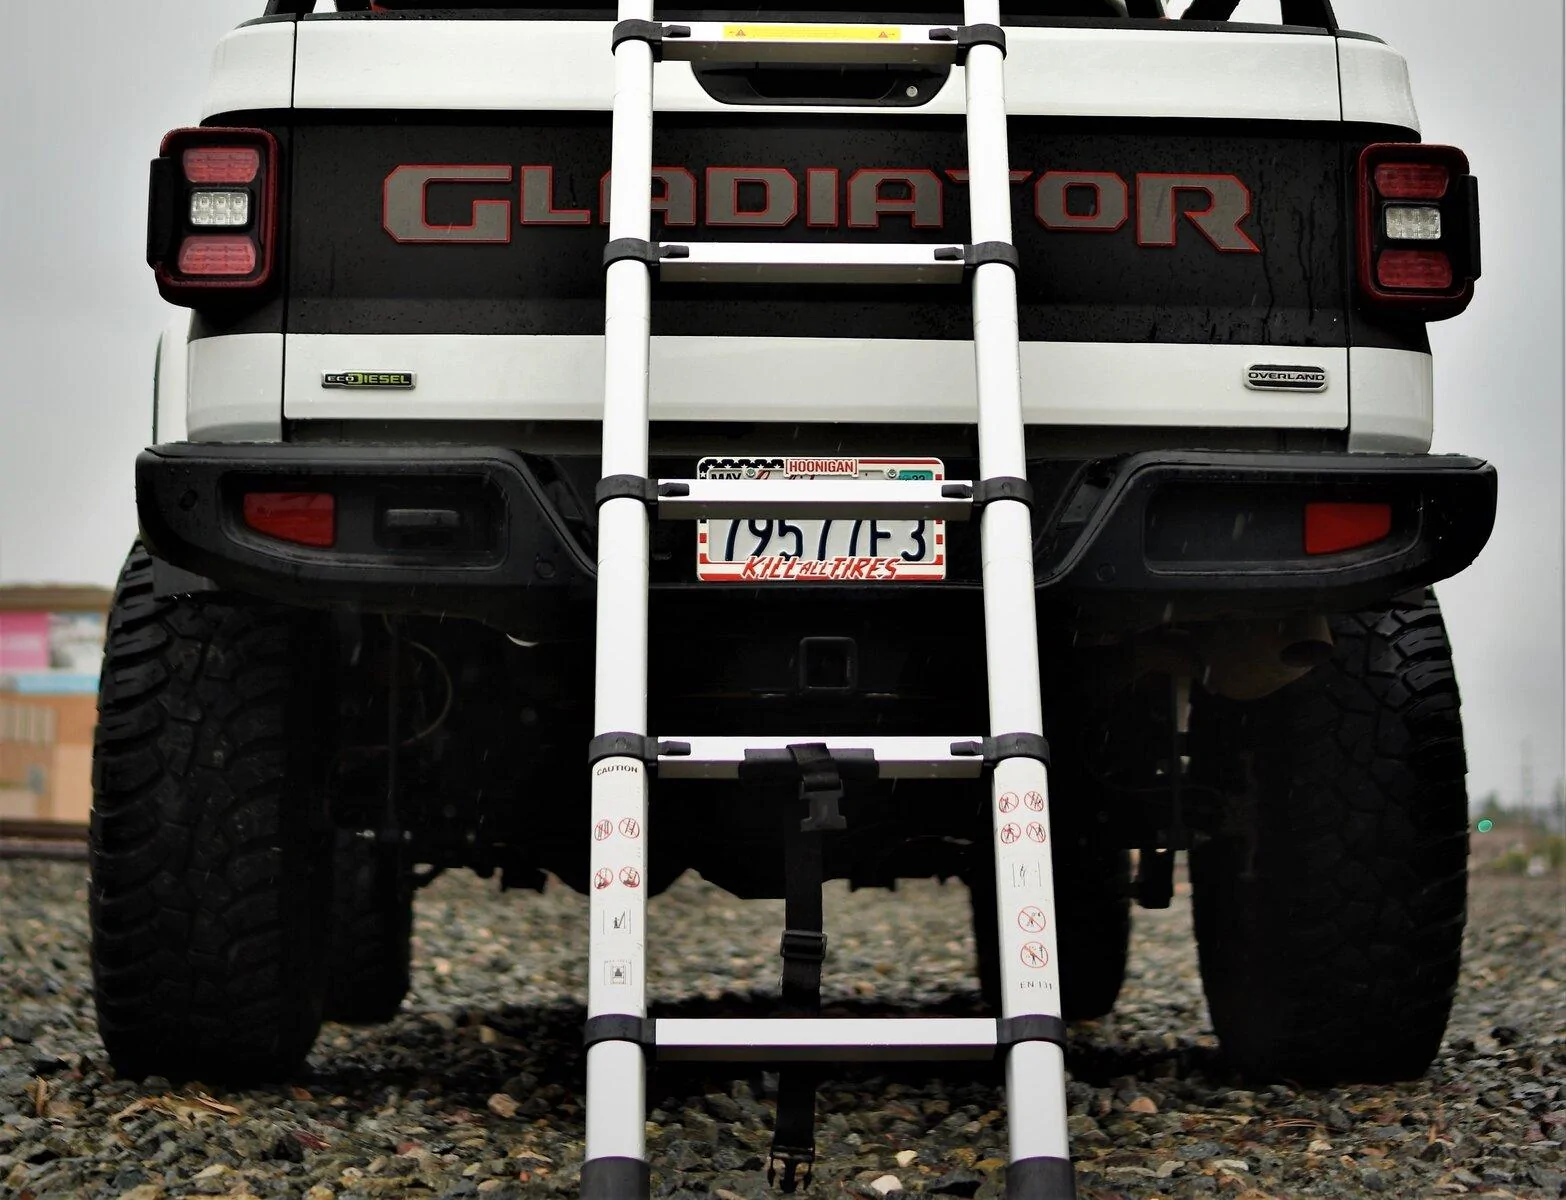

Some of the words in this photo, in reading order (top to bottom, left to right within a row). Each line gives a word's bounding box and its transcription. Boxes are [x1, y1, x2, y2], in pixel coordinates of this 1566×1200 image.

[1248, 372, 1325, 380] OVERLAND
[741, 557, 799, 579] KILL
[800, 560, 828, 575] ALL
[829, 557, 901, 579] TIRES
[597, 765, 638, 776] CAUTION
